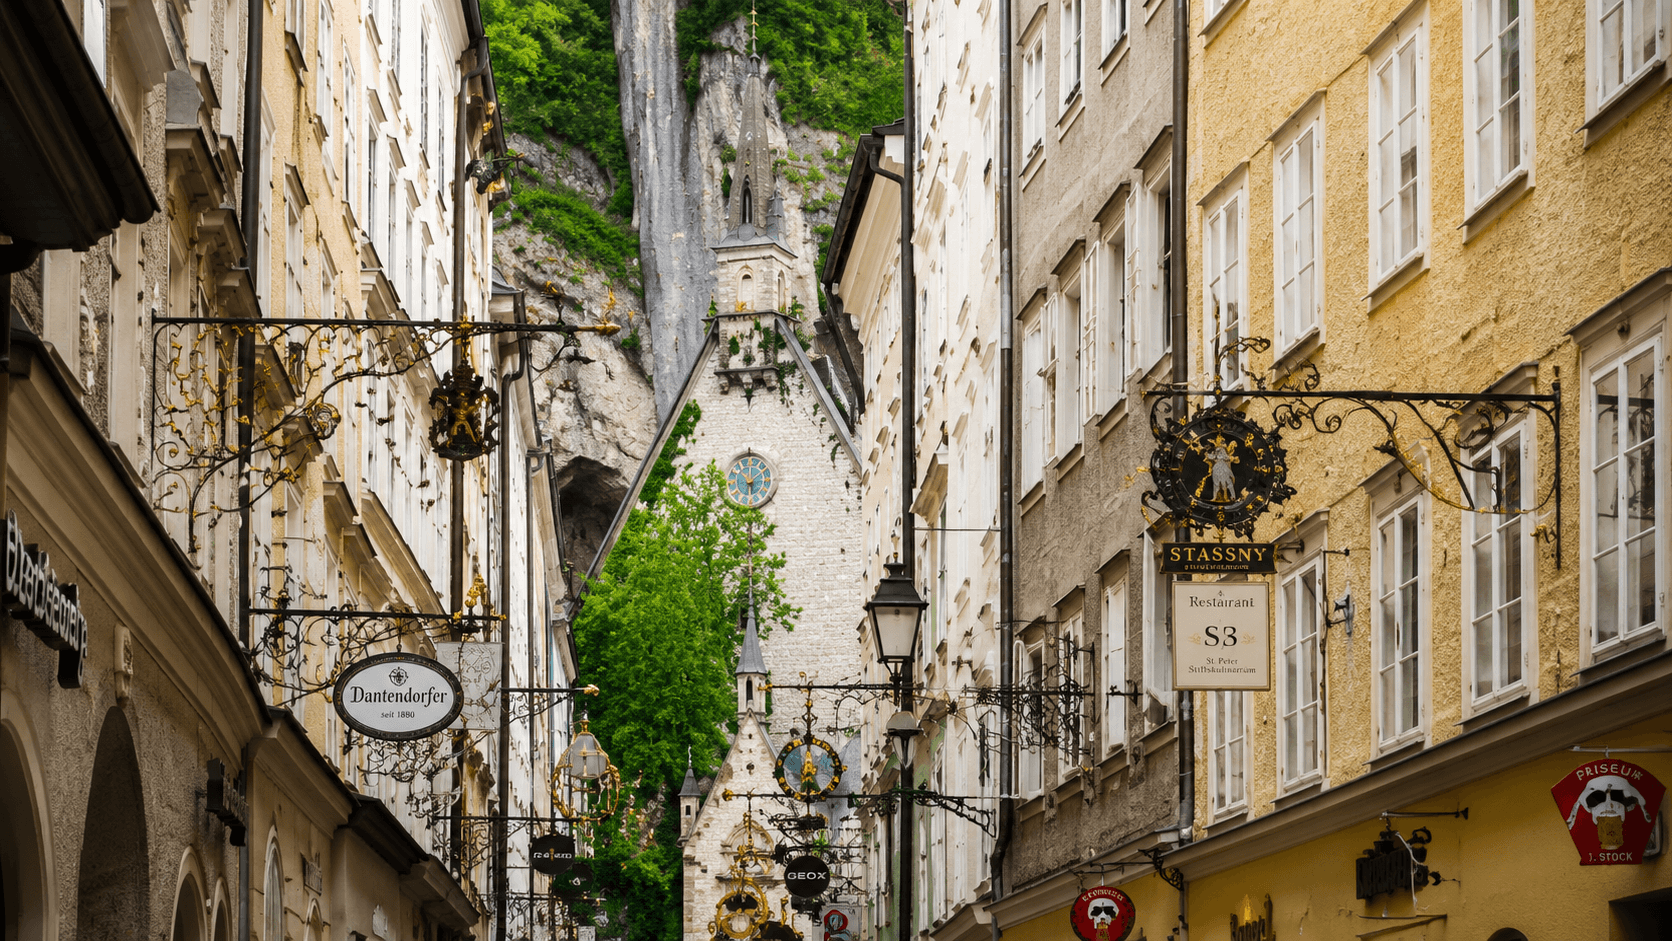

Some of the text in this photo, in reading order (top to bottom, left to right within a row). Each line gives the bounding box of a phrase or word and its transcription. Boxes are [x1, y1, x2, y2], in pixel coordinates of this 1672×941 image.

[1170, 547, 1267, 562] STASSNY
[350, 685, 448, 708] Dantendorfer
[380, 710, 415, 719] seit 1880
[1599, 852, 1633, 862] STOCK
[787, 871, 827, 880] GEOX
